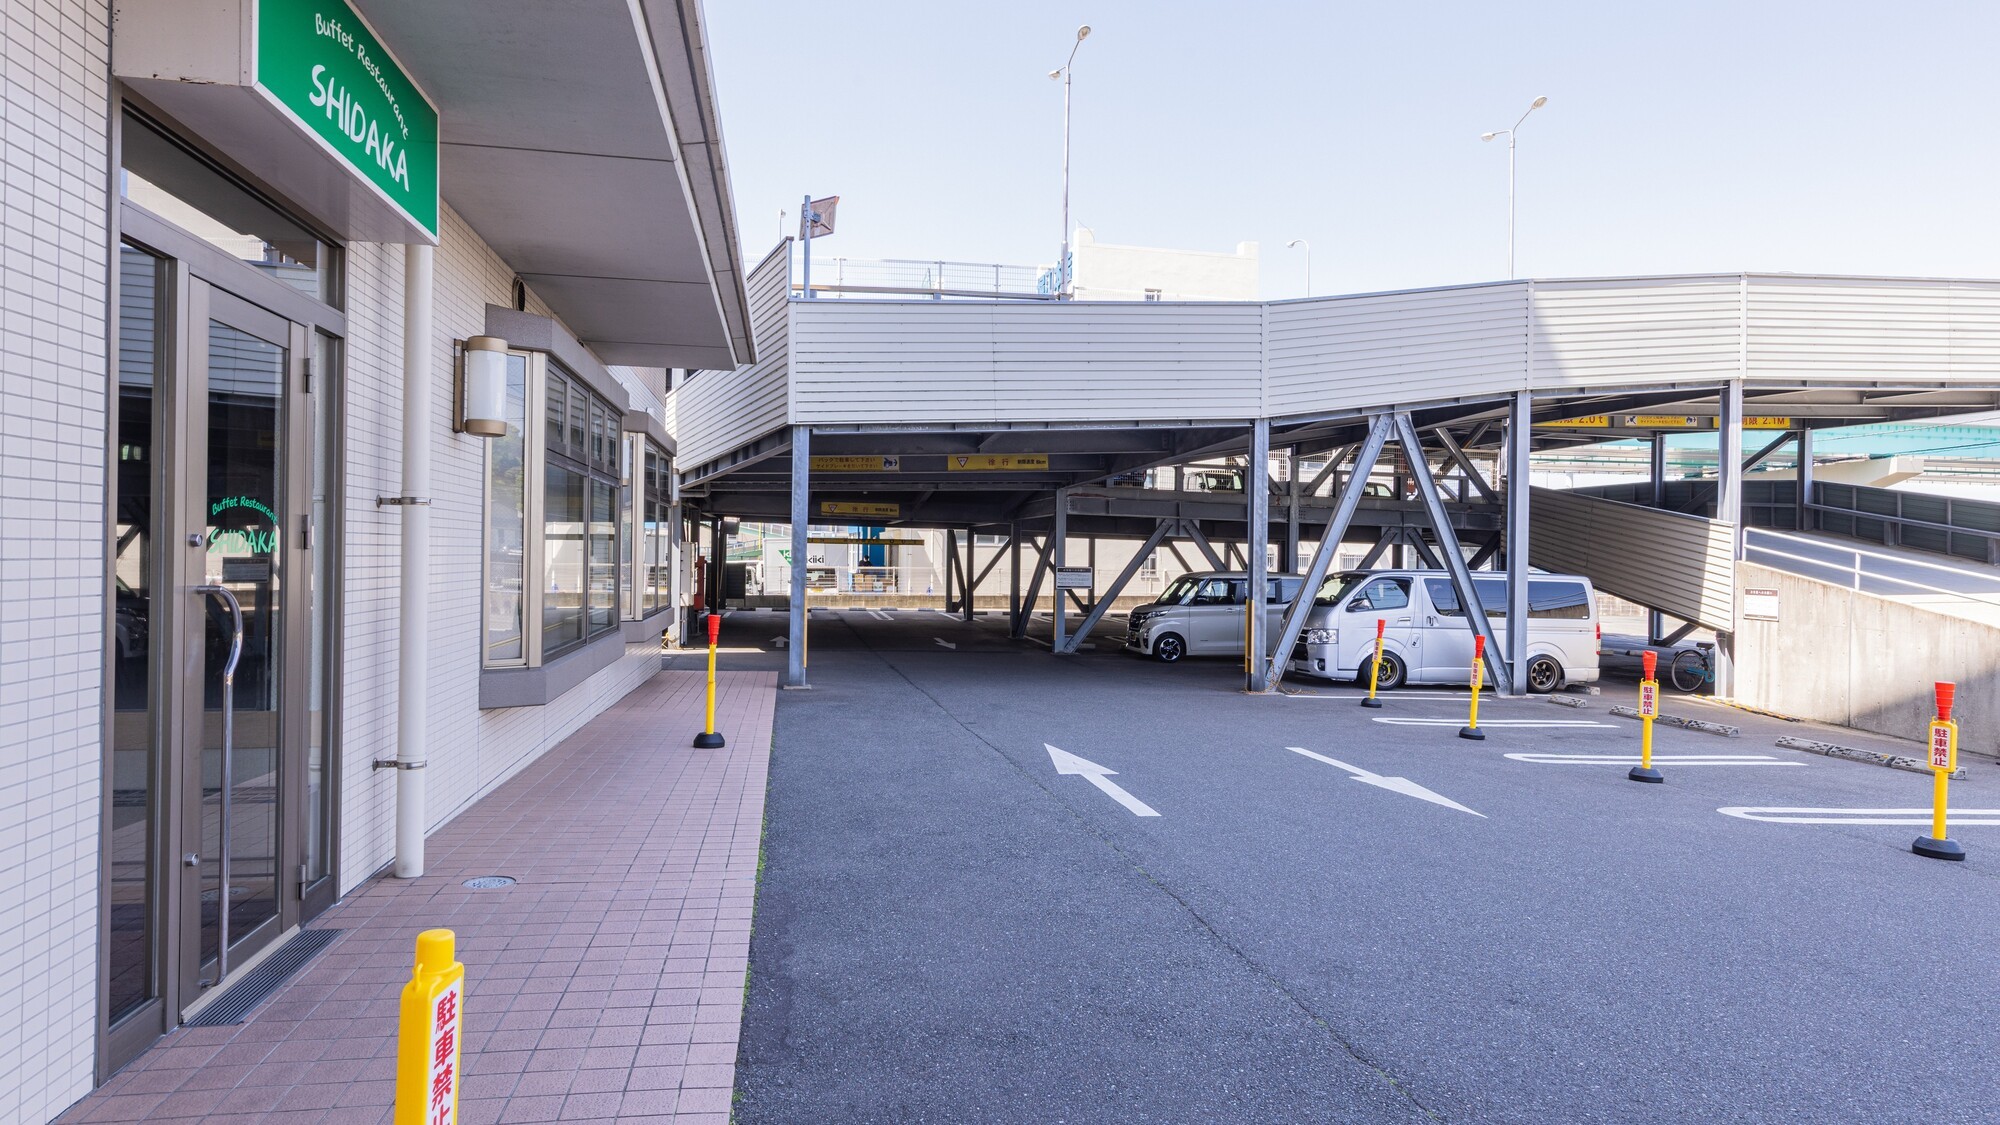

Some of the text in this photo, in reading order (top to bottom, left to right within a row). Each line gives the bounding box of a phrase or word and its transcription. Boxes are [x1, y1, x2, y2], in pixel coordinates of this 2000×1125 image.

[315, 13, 409, 140] Buffet Restaurant
[309, 64, 409, 192] SHIDAKA
[212, 495, 278, 525] Buffet Restaurant
[209, 529, 278, 553] SHIDAKA
[1642, 686, 1653, 715] 駐車禁止
[1933, 728, 1948, 767] 駐車禁止
